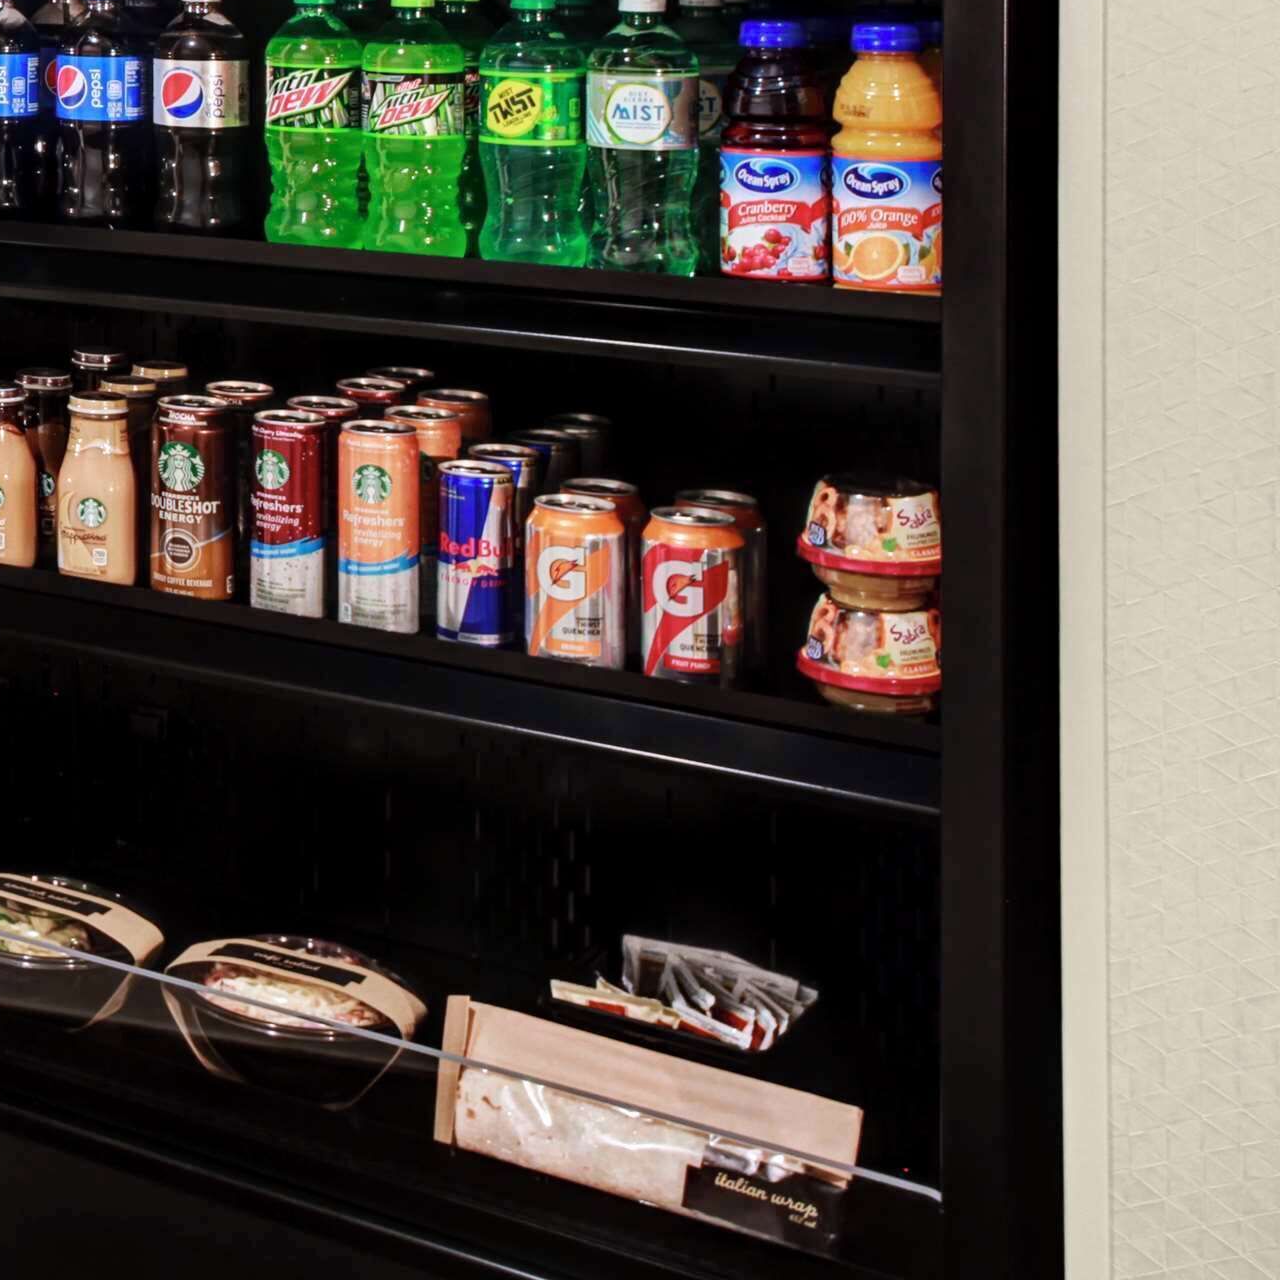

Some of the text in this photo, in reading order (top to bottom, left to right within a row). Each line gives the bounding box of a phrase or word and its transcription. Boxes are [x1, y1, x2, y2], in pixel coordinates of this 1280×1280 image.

[90, 68, 103, 109] pepsi
[213, 73, 225, 119] pepsi
[611, 103, 665, 121] MIST
[737, 201, 798, 217] Cranberry
[841, 207, 919, 228] 100% Orange
[151, 493, 219, 515] DOUBLESHOT
[159, 510, 204, 525] ENERGY
[255, 521, 282, 533] energy
[897, 508, 933, 529] Sabra
[439, 531, 476, 558] Red
[537, 545, 587, 602] G
[651, 559, 705, 617] G
[890, 624, 926, 645] Sabra
[714, 1171, 819, 1219] italian wrap
